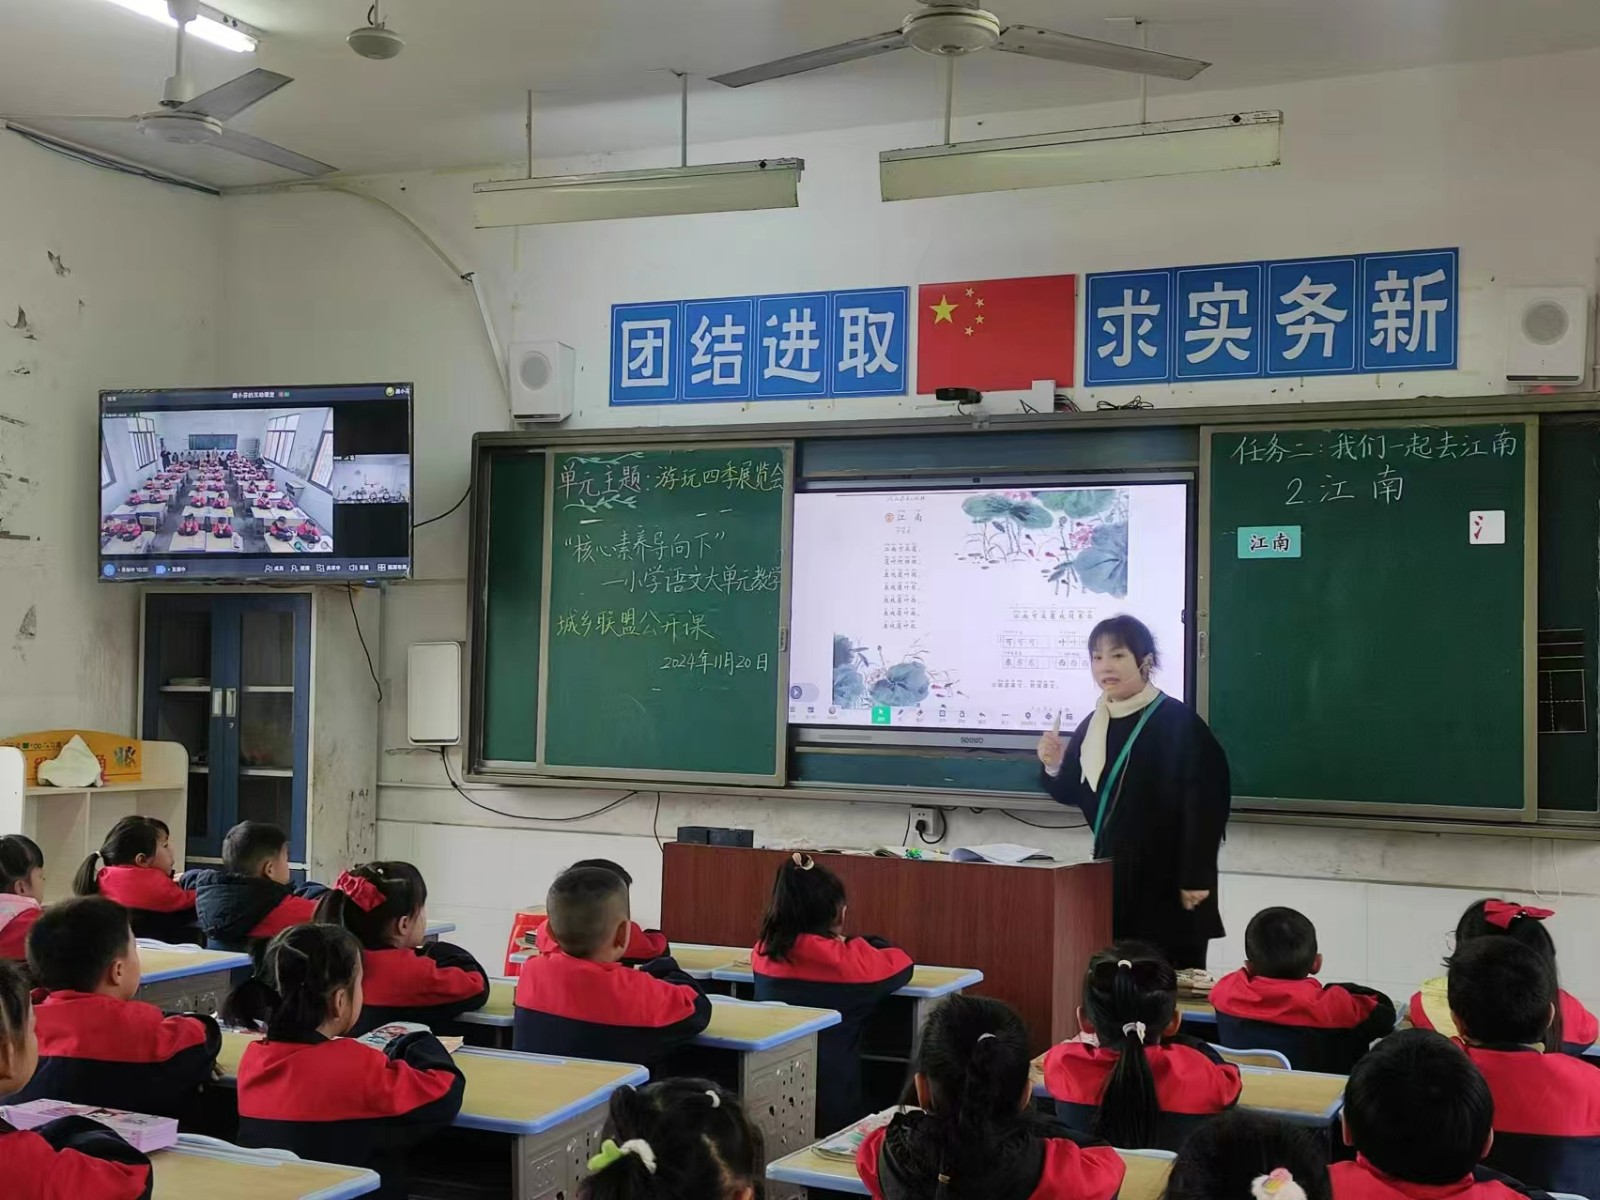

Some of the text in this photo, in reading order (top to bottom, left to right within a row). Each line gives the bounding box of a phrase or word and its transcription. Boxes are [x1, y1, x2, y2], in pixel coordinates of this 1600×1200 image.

[620, 268, 1448, 389] 团结进取 求实务新
[1250, 533, 1290, 552] 江南
[557, 608, 716, 643] 城乡联盟公开课
[660, 648, 768, 676] 2024年11月20日
